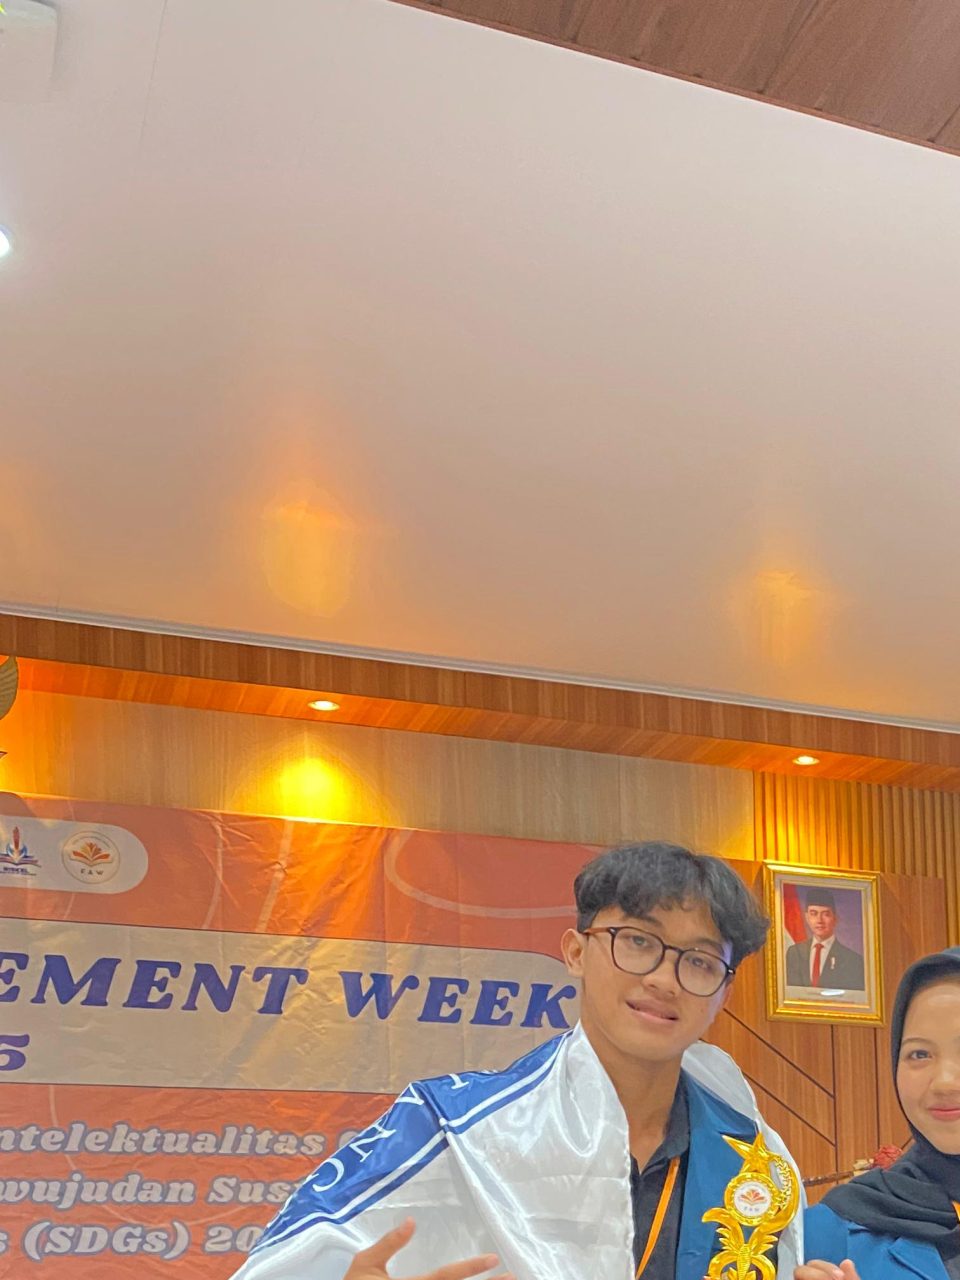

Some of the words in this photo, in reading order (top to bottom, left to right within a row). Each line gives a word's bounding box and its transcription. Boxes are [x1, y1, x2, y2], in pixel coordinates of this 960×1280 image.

[339, 970, 578, 1030] WEEK
[0, 1174, 196, 1208] wujudan
[23, 1220, 190, 1261] (SDGs)
